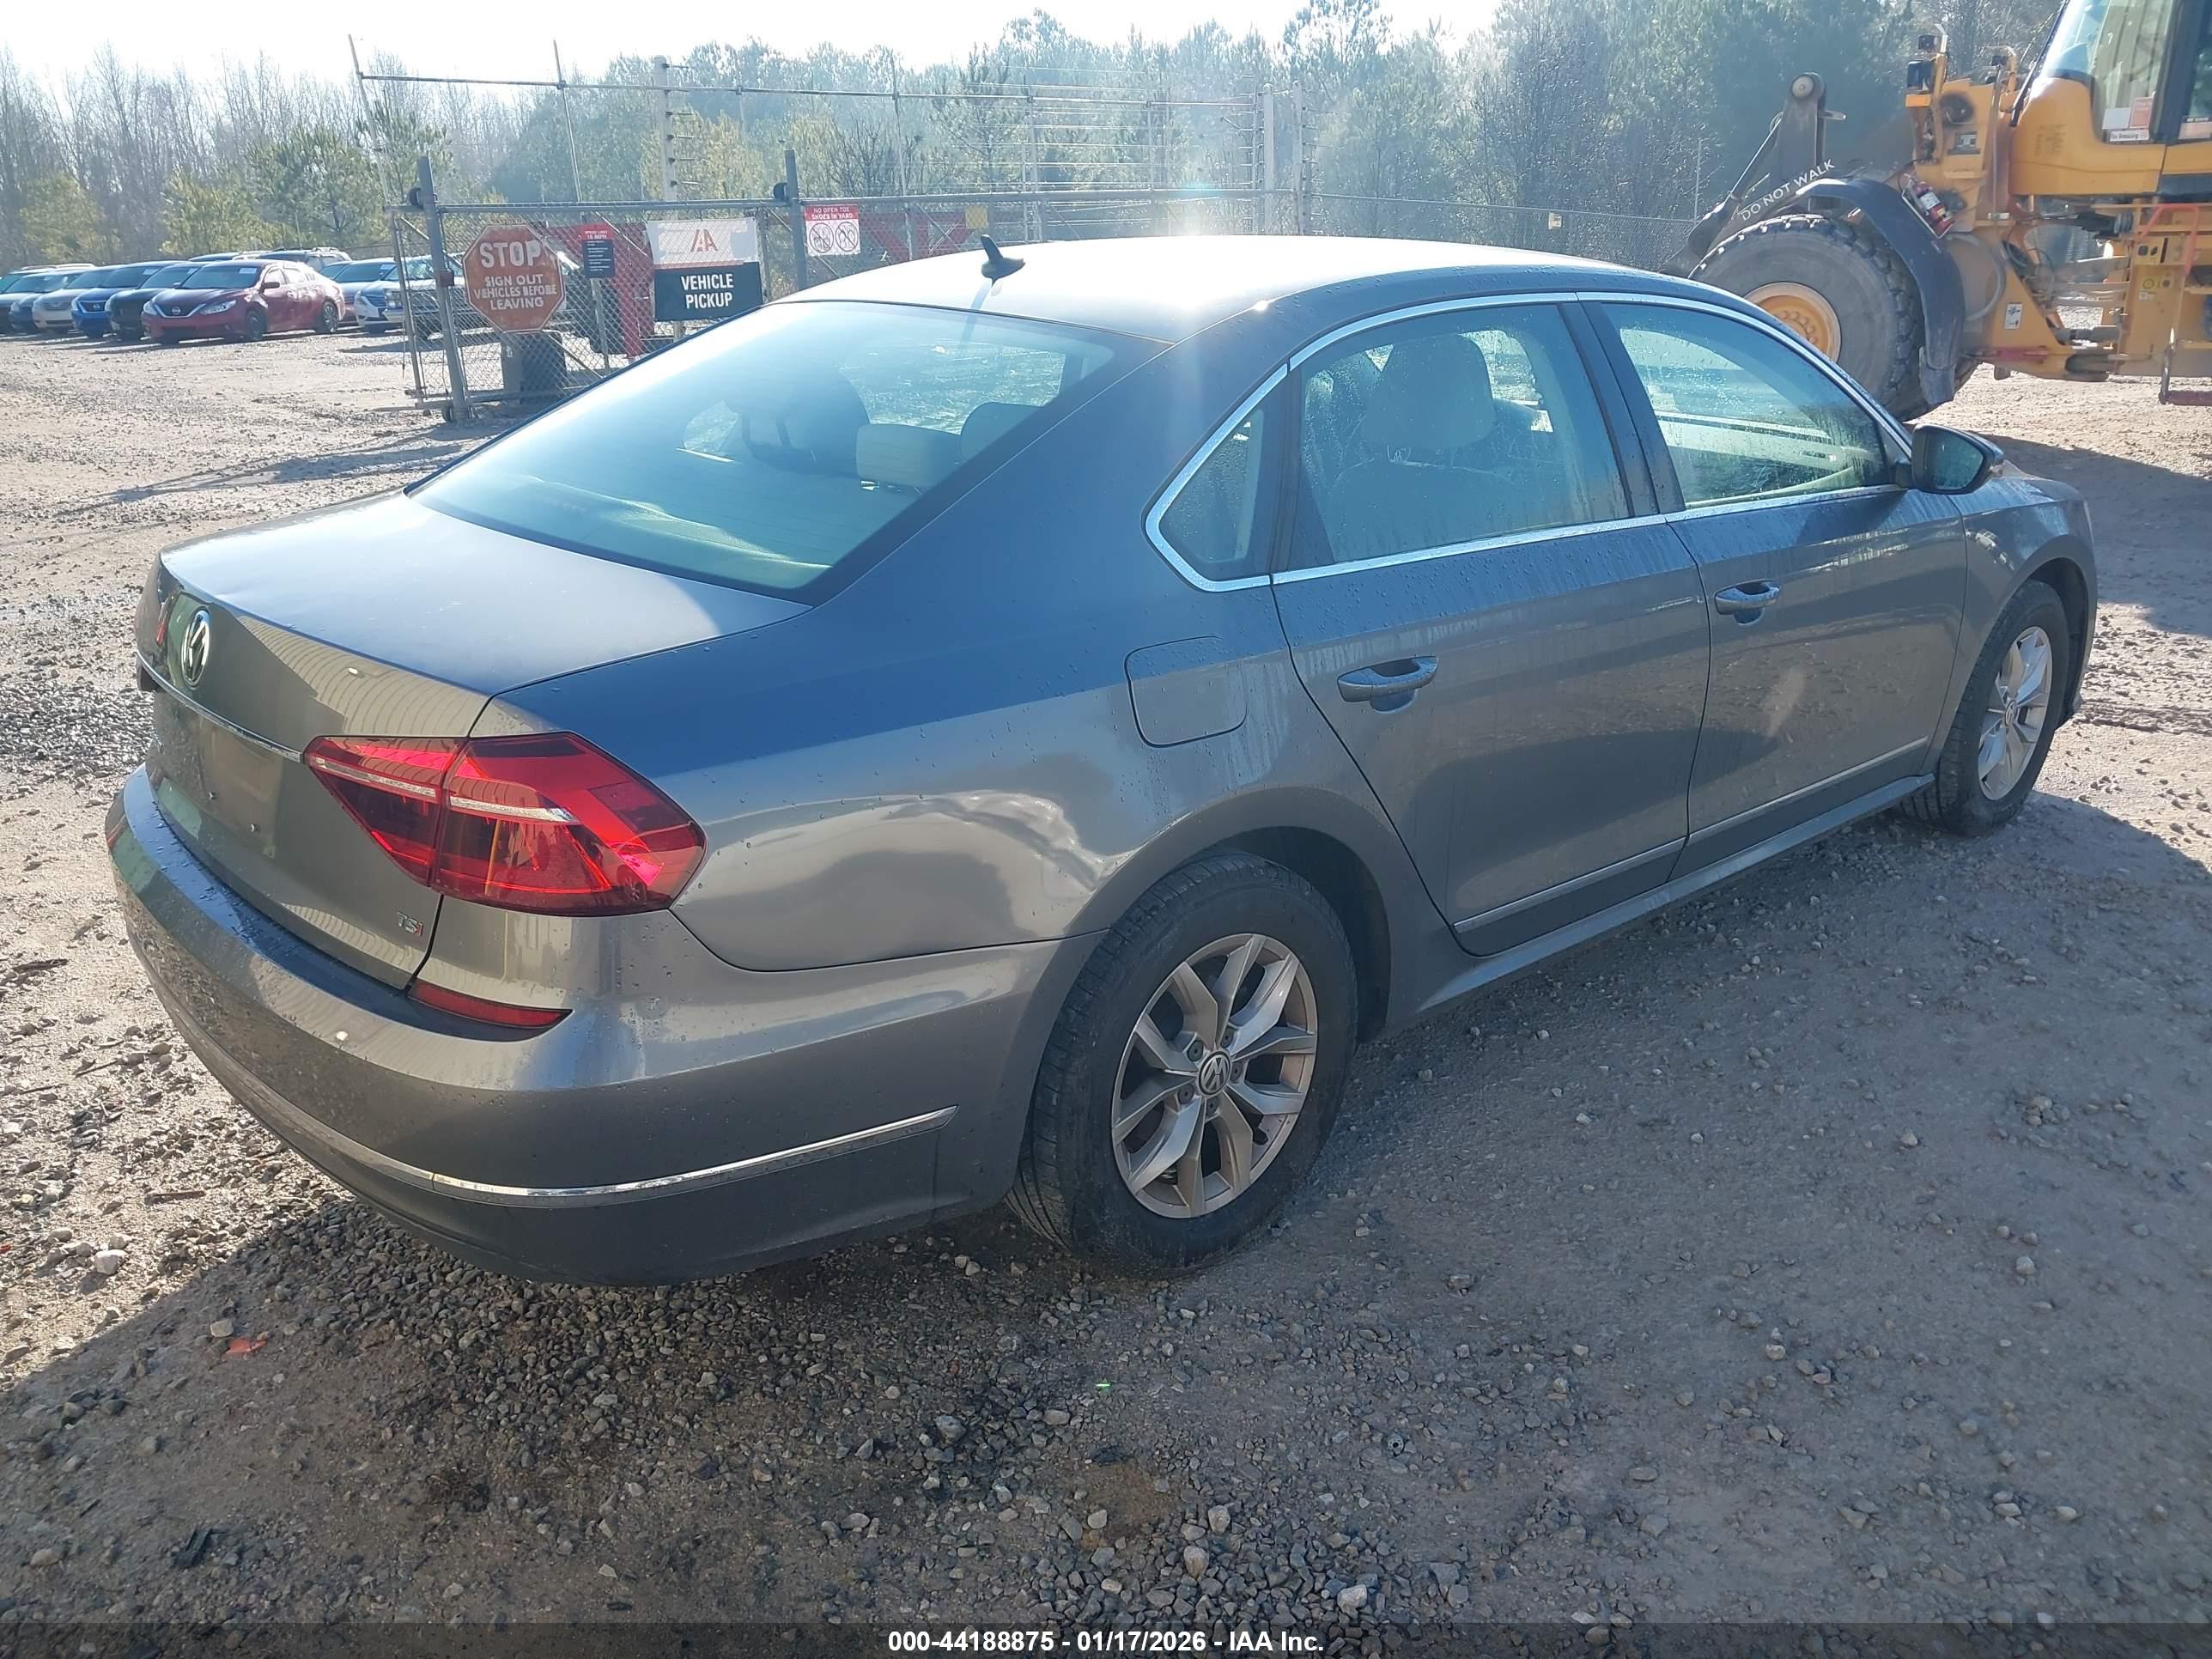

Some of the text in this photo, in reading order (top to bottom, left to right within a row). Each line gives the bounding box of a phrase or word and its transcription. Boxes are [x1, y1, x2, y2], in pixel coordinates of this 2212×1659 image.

[1741, 159, 1835, 221] DO NOT WALK
[479, 240, 541, 268] STOP
[484, 274, 544, 288] SIGN OUT
[680, 273, 734, 291] VEHICLE
[473, 284, 557, 299] VEHICLES BEFORE
[489, 296, 544, 310] LEAVING
[685, 292, 733, 309] PICKUP
